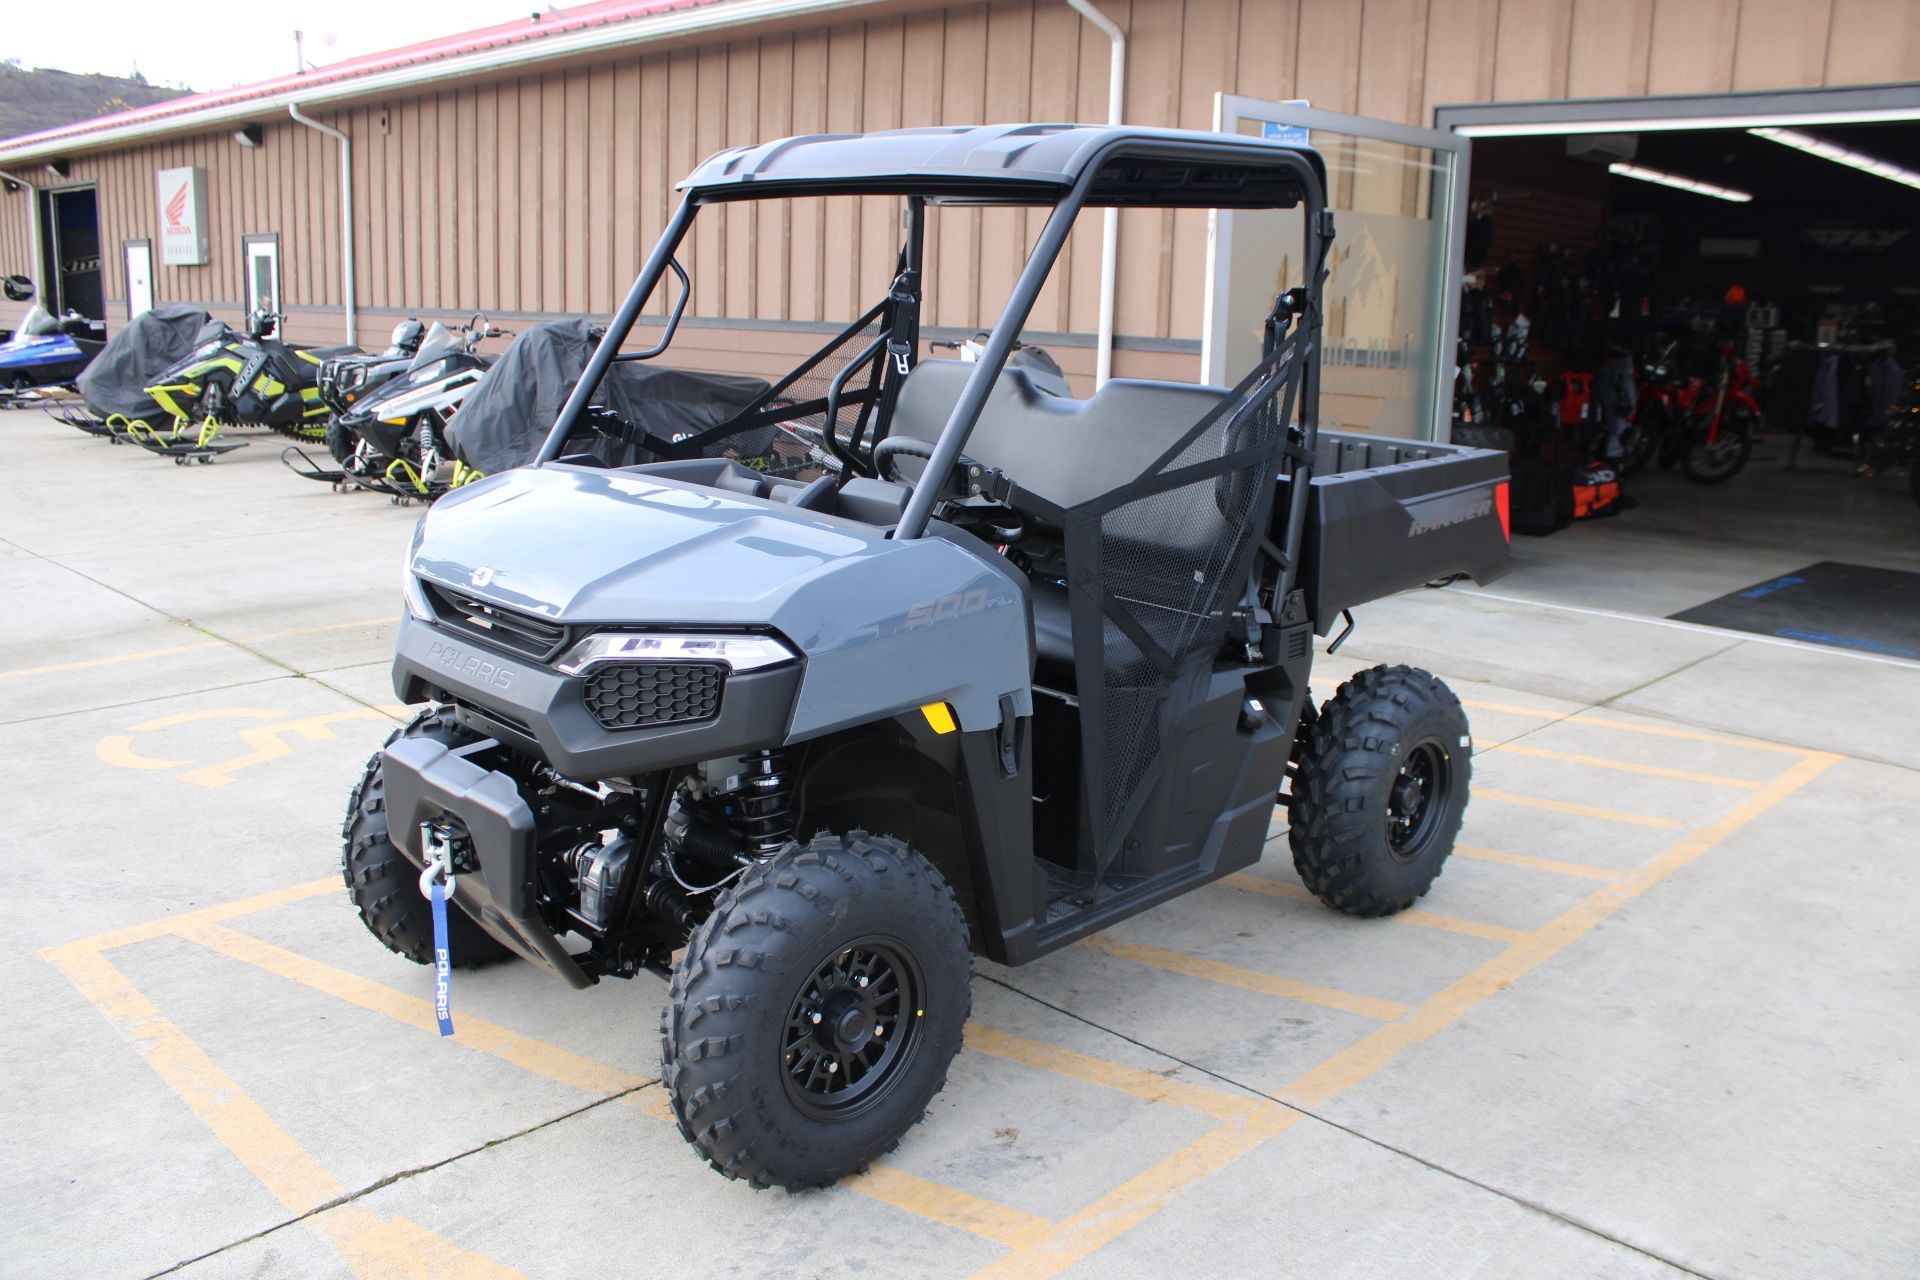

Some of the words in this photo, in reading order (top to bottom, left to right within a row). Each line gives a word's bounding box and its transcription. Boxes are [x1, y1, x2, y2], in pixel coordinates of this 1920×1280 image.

[166, 225, 193, 236] HONDA
[1407, 498, 1492, 538] RANGER
[904, 588, 989, 626] 500
[426, 641, 514, 690] POLARIS
[436, 948, 450, 1021] POLARIS
